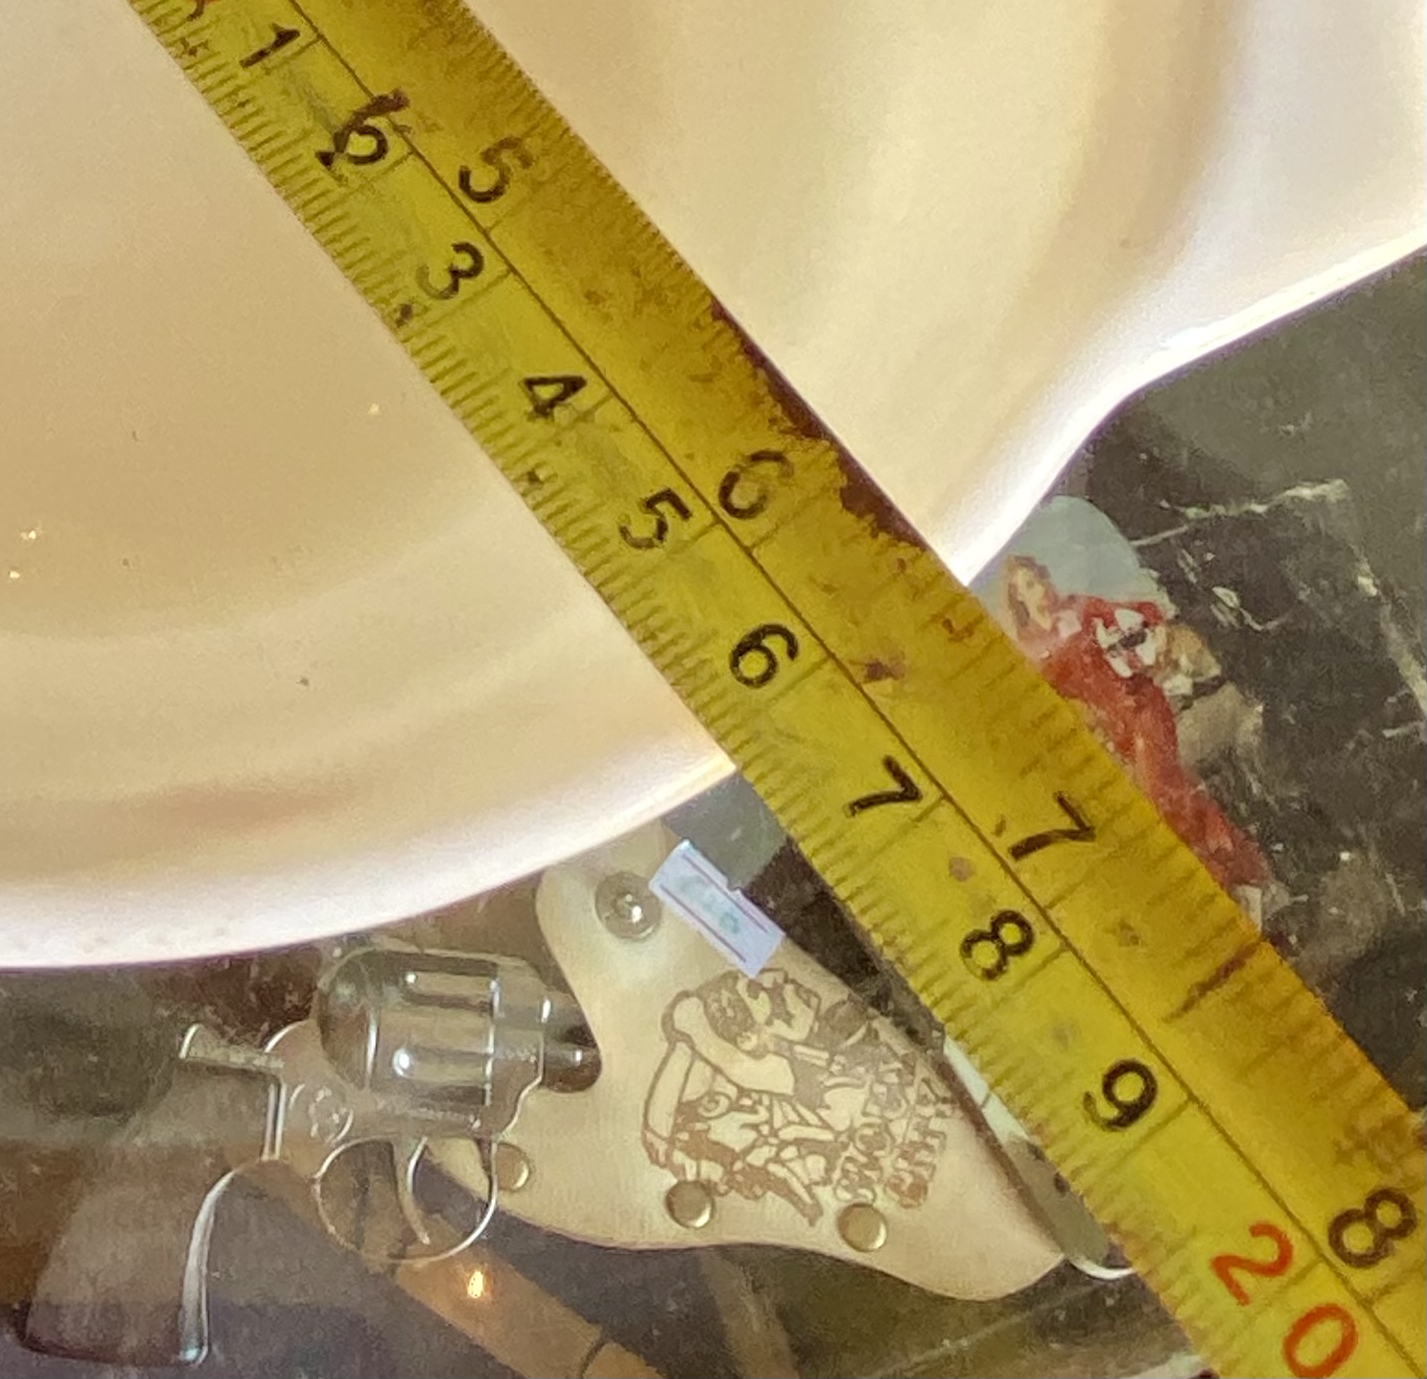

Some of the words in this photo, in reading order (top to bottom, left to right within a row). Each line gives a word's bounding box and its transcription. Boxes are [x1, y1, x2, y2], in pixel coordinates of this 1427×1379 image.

[238, 24, 300, 68] 1
[417, 241, 485, 300] 3
[519, 375, 587, 421] 4
[619, 488, 693, 550] 5
[729, 624, 799, 688] 6
[845, 756, 923, 818] 7
[960, 910, 1034, 981] 8
[1082, 1059, 1158, 1131] 9
[1209, 1223, 1359, 1379] 20
[458, 135, 535, 204] 5
[718, 450, 794, 520] 6
[1008, 791, 1097, 862] 7
[1327, 1188, 1418, 1270] 8
